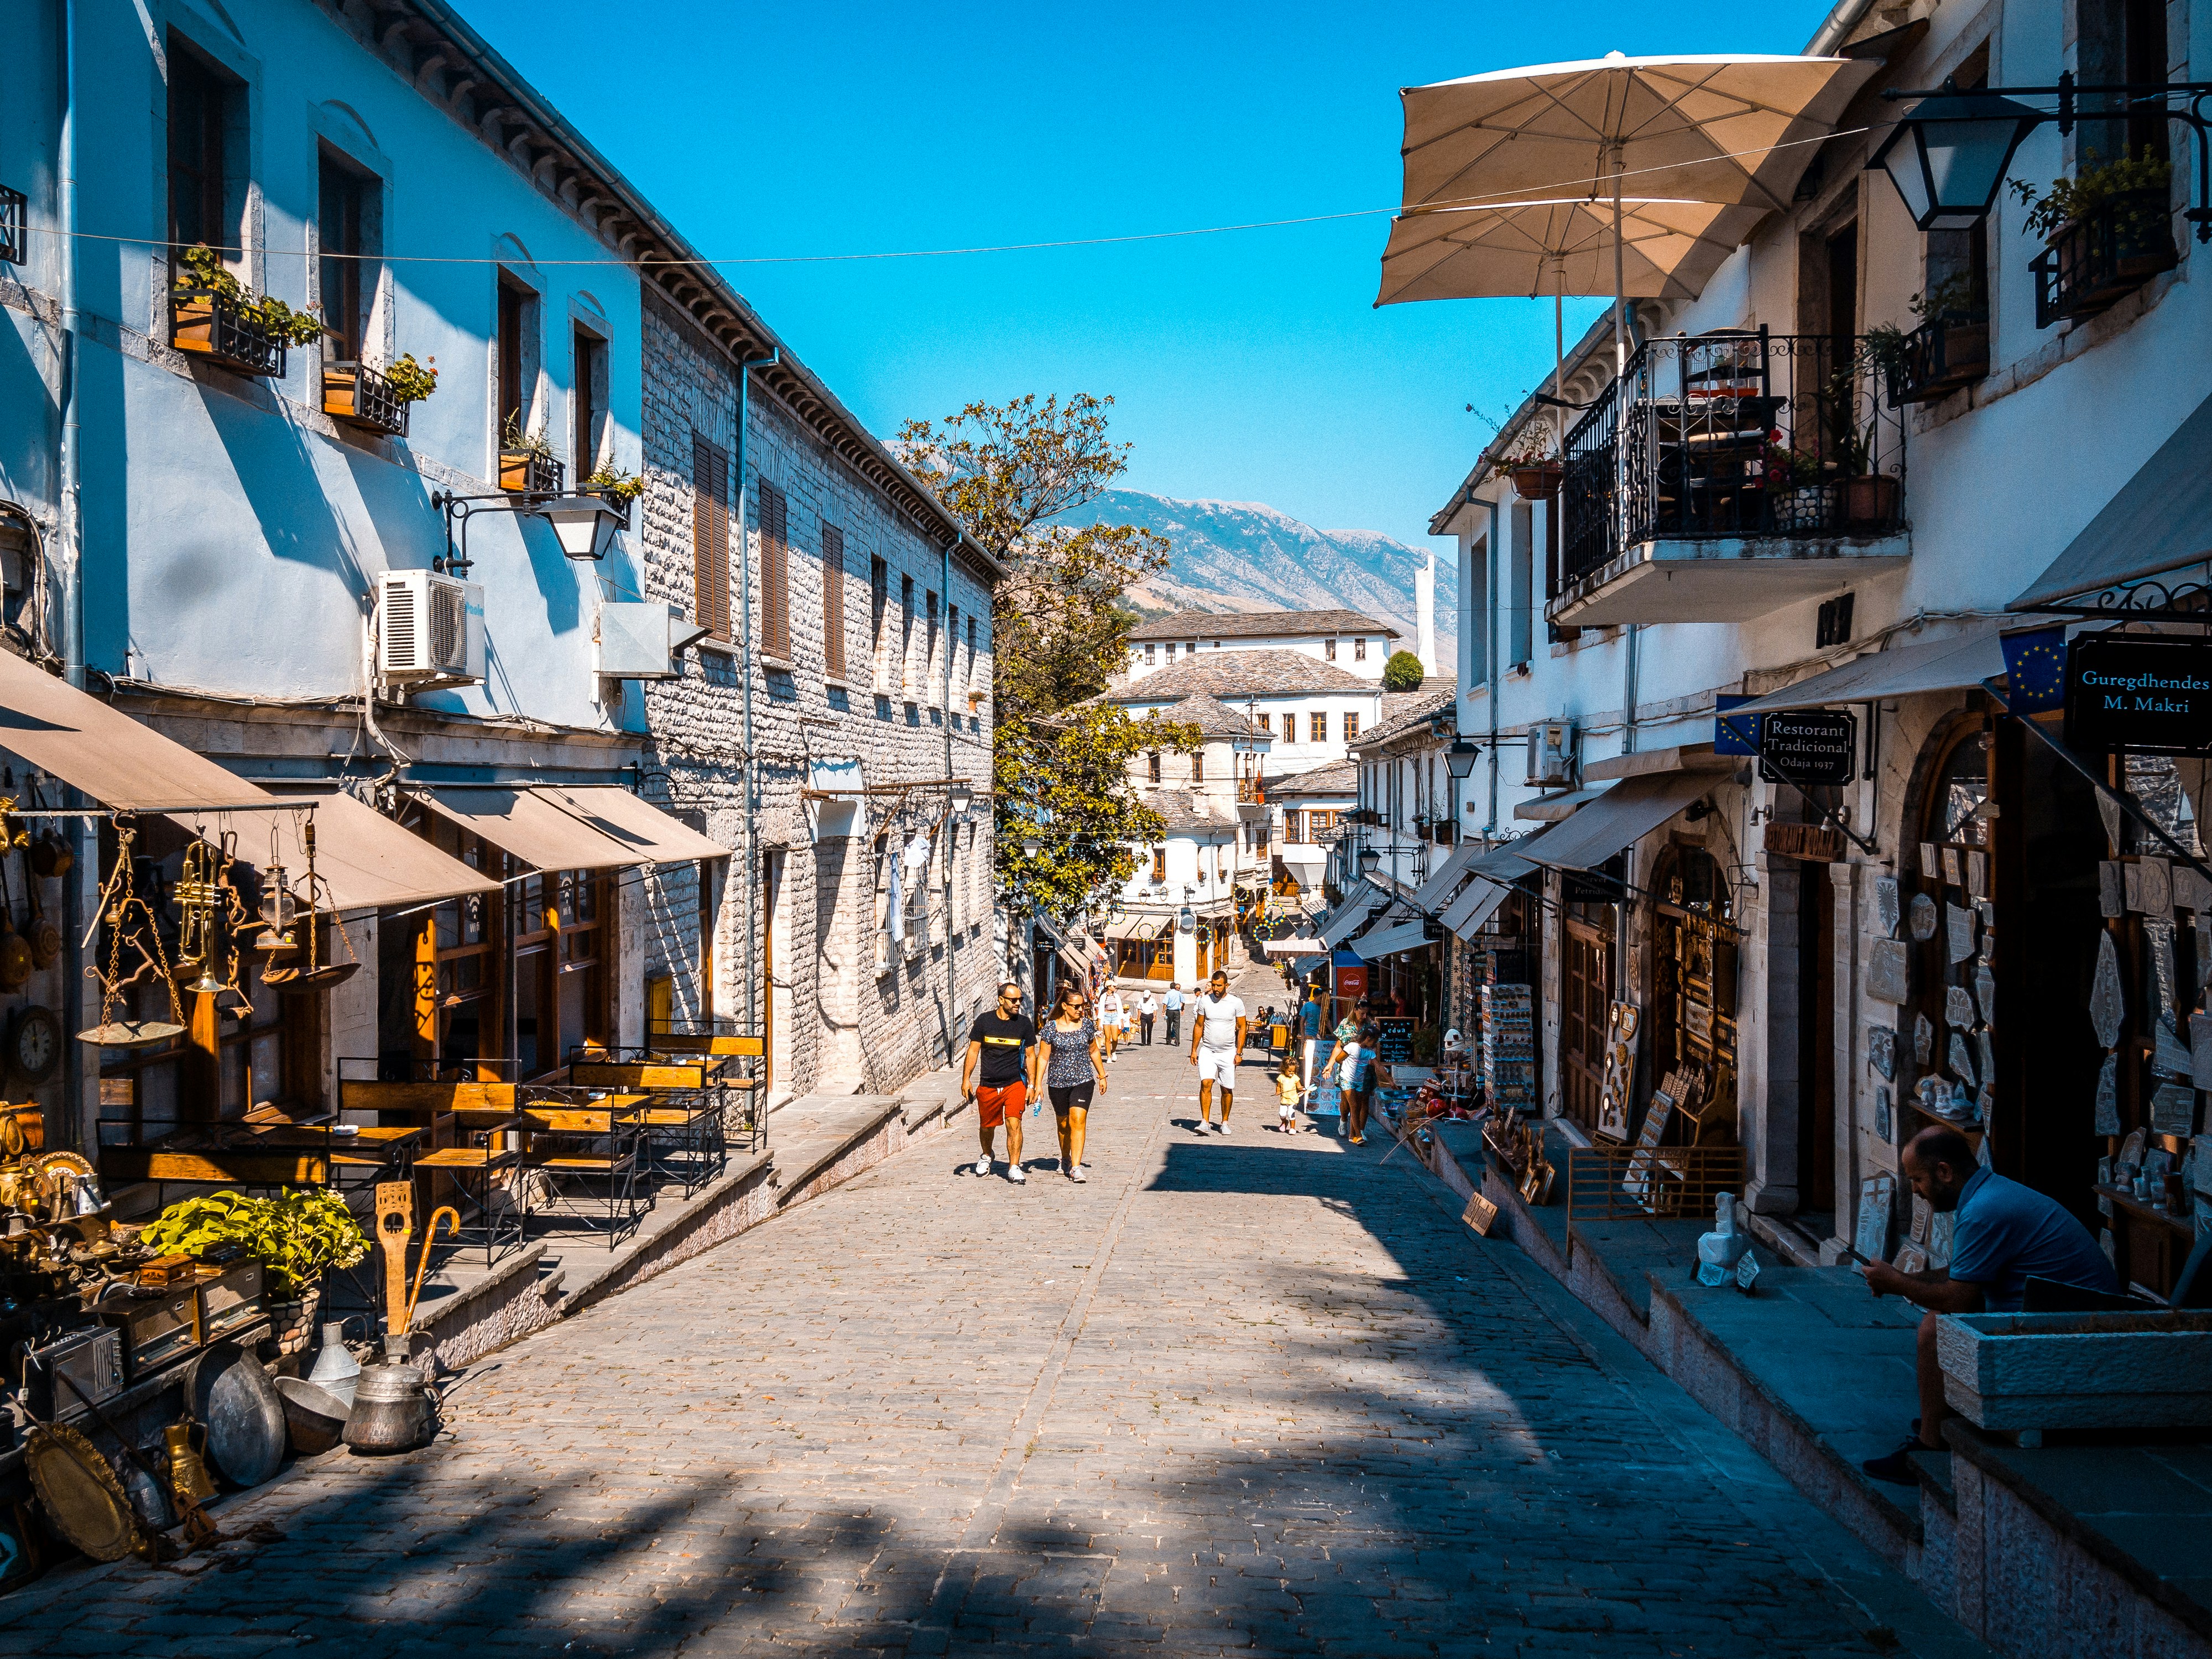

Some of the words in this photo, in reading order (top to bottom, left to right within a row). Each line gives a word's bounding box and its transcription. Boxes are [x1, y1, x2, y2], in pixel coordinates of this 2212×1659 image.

[2082, 671, 2210, 691] Guregdhendes
[2103, 695, 2128, 709] M.
[2134, 696, 2189, 712] Makri
[1772, 721, 1845, 737] Restorant
[1767, 738, 1848, 753] Tradicional
[1780, 757, 1811, 770] Odaja
[1814, 761, 1834, 770] 1937
